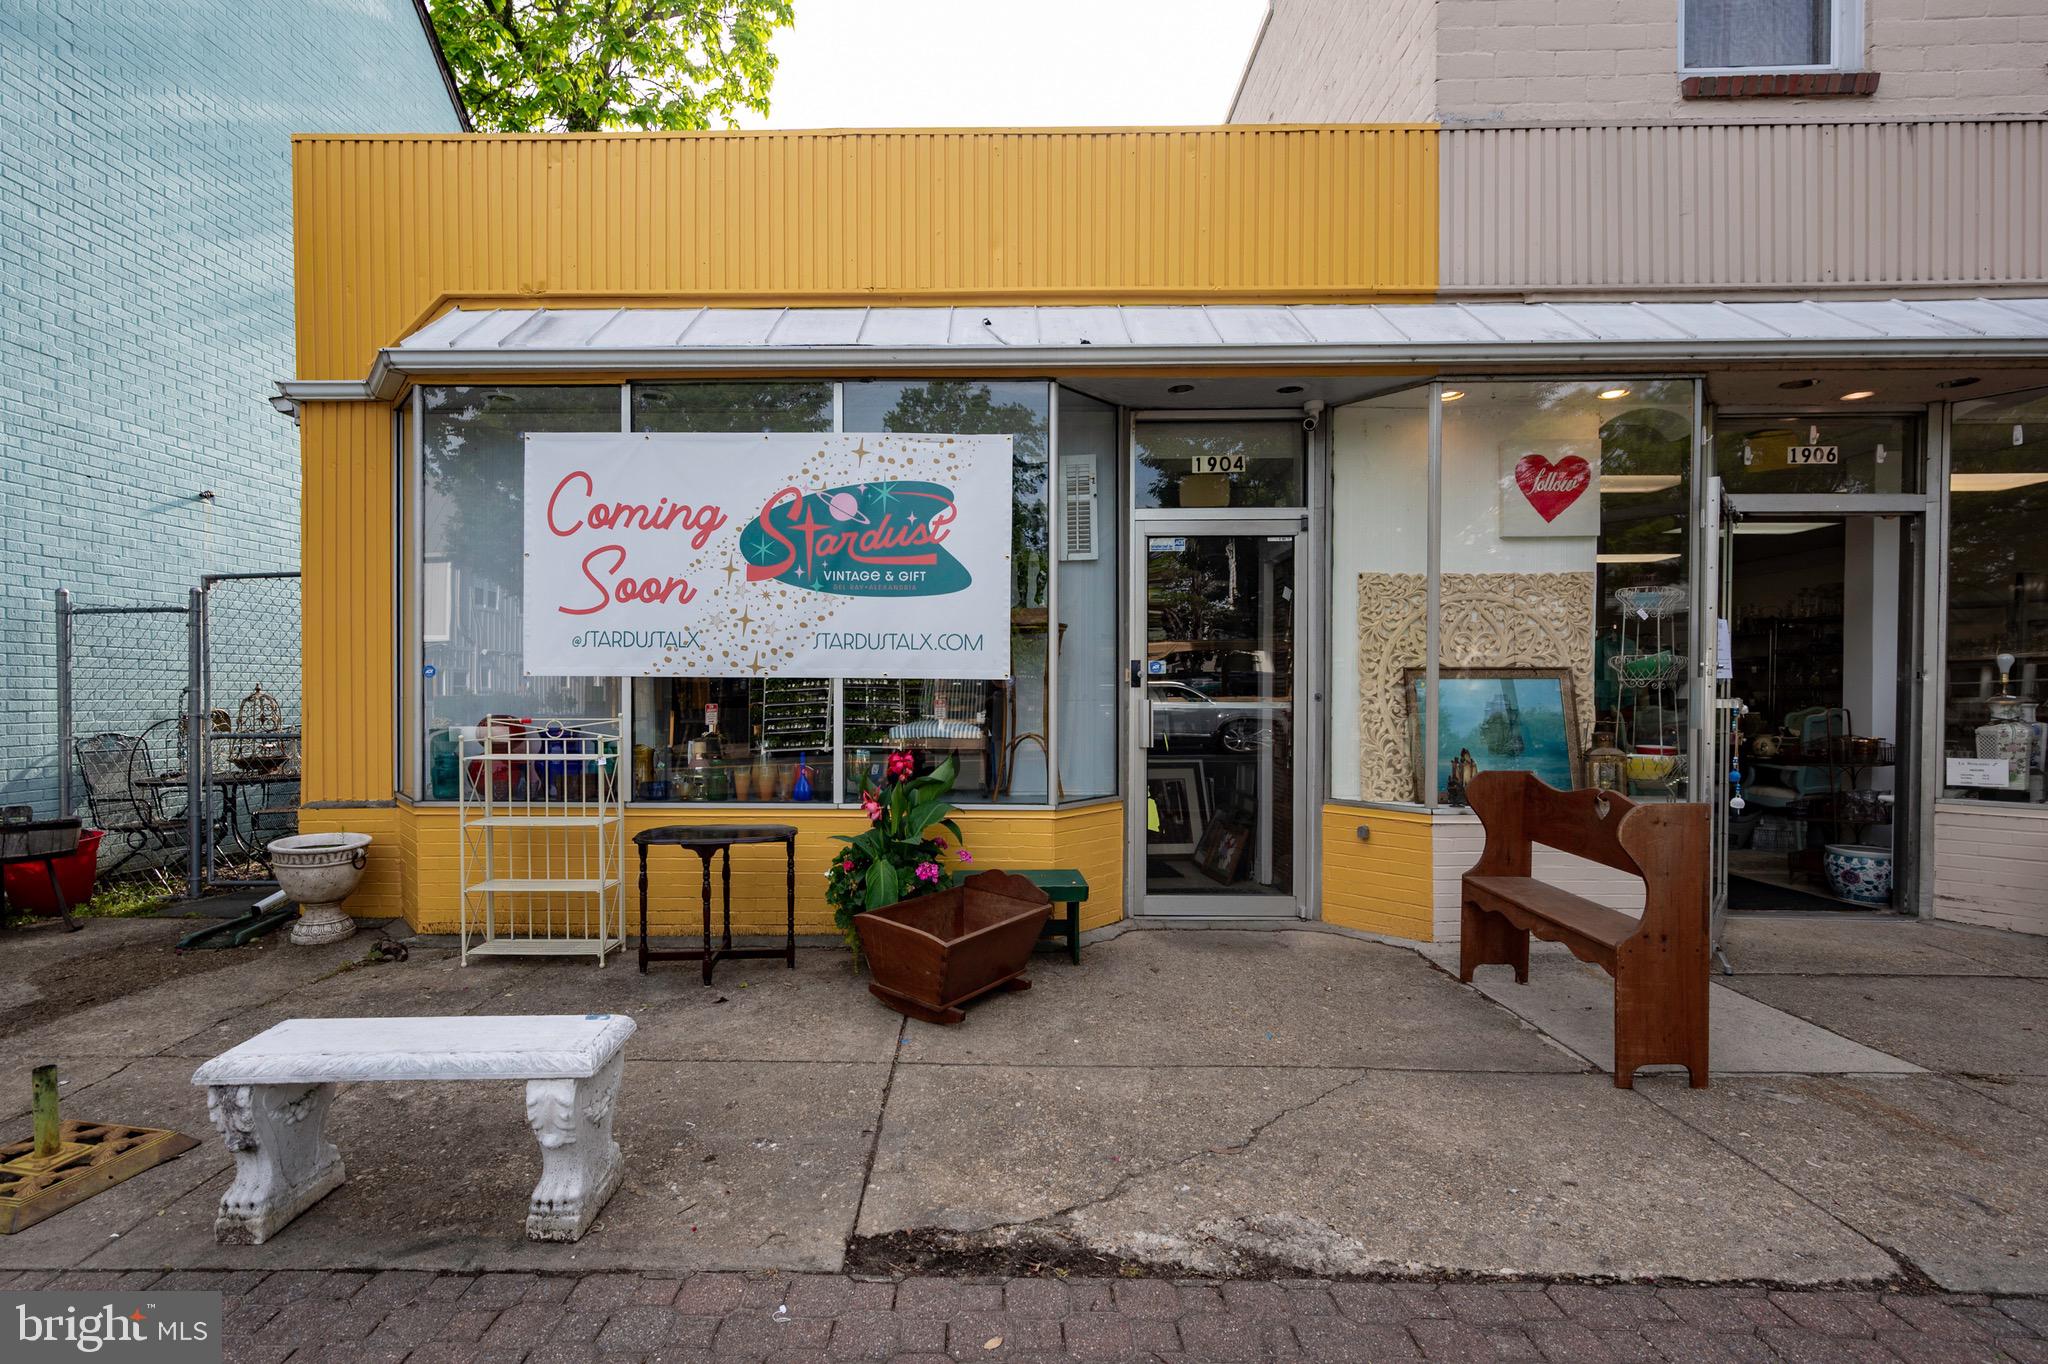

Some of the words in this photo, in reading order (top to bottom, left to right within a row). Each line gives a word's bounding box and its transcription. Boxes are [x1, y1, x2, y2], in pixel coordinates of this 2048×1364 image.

[1196, 456, 1243, 472] 1904
[1791, 447, 1836, 463] 1906
[547, 470, 728, 550] Coming
[746, 485, 958, 582] Stardust
[558, 544, 698, 615] Soon
[884, 570, 894, 582] &
[898, 570, 926, 582] GIFT
[572, 630, 700, 648] @STARDUSTALX
[812, 632, 984, 651] STARDUSTALX.COM
